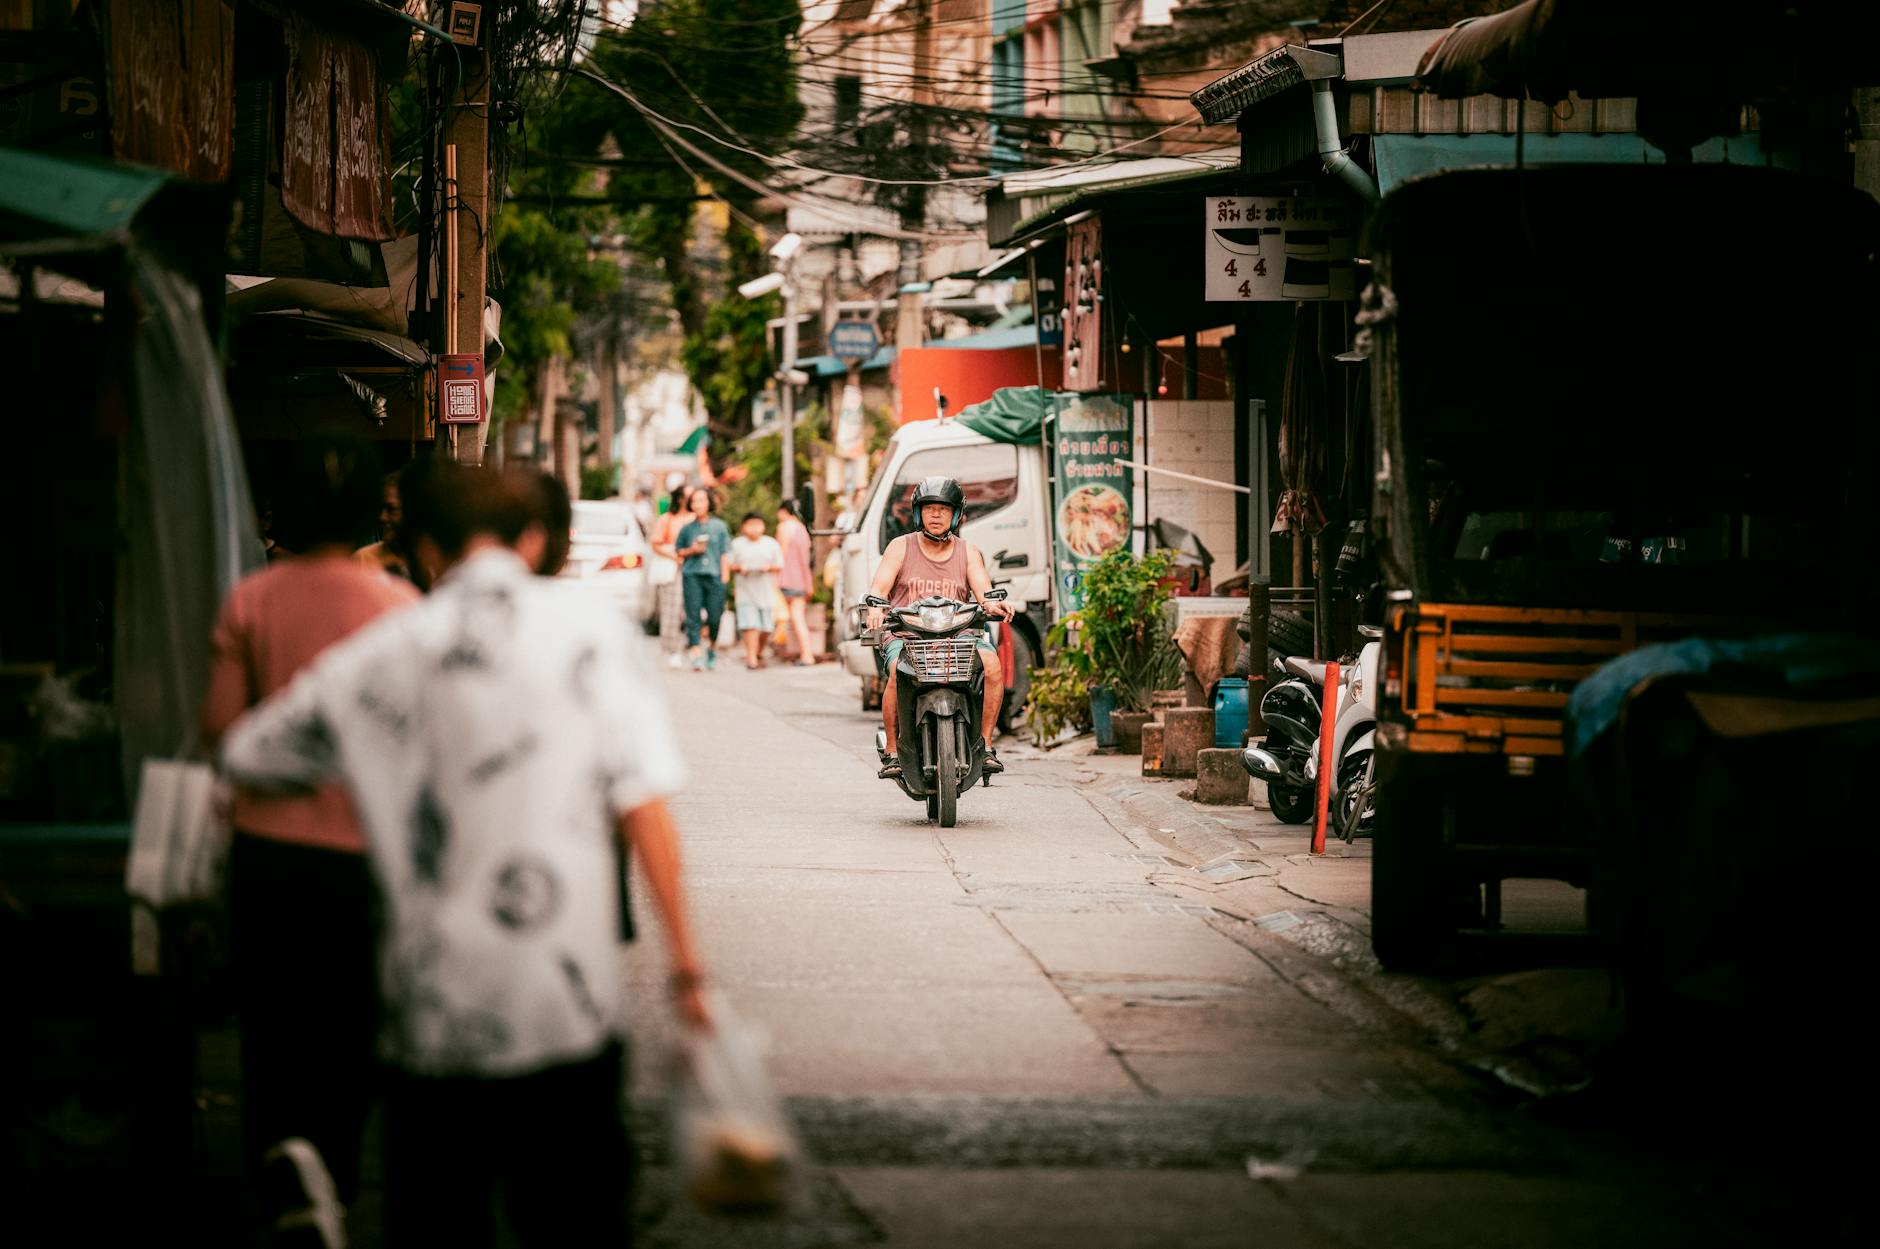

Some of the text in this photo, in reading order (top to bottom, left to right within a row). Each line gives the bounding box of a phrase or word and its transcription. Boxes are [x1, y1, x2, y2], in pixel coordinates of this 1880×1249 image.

[1225, 258, 1267, 277] 4 4
[1238, 280, 1251, 298] 4
[450, 386, 475, 396] HONG
[450, 396, 475, 405] SIENG
[450, 405, 476, 415] KONG
[907, 578, 958, 603] MODERN
